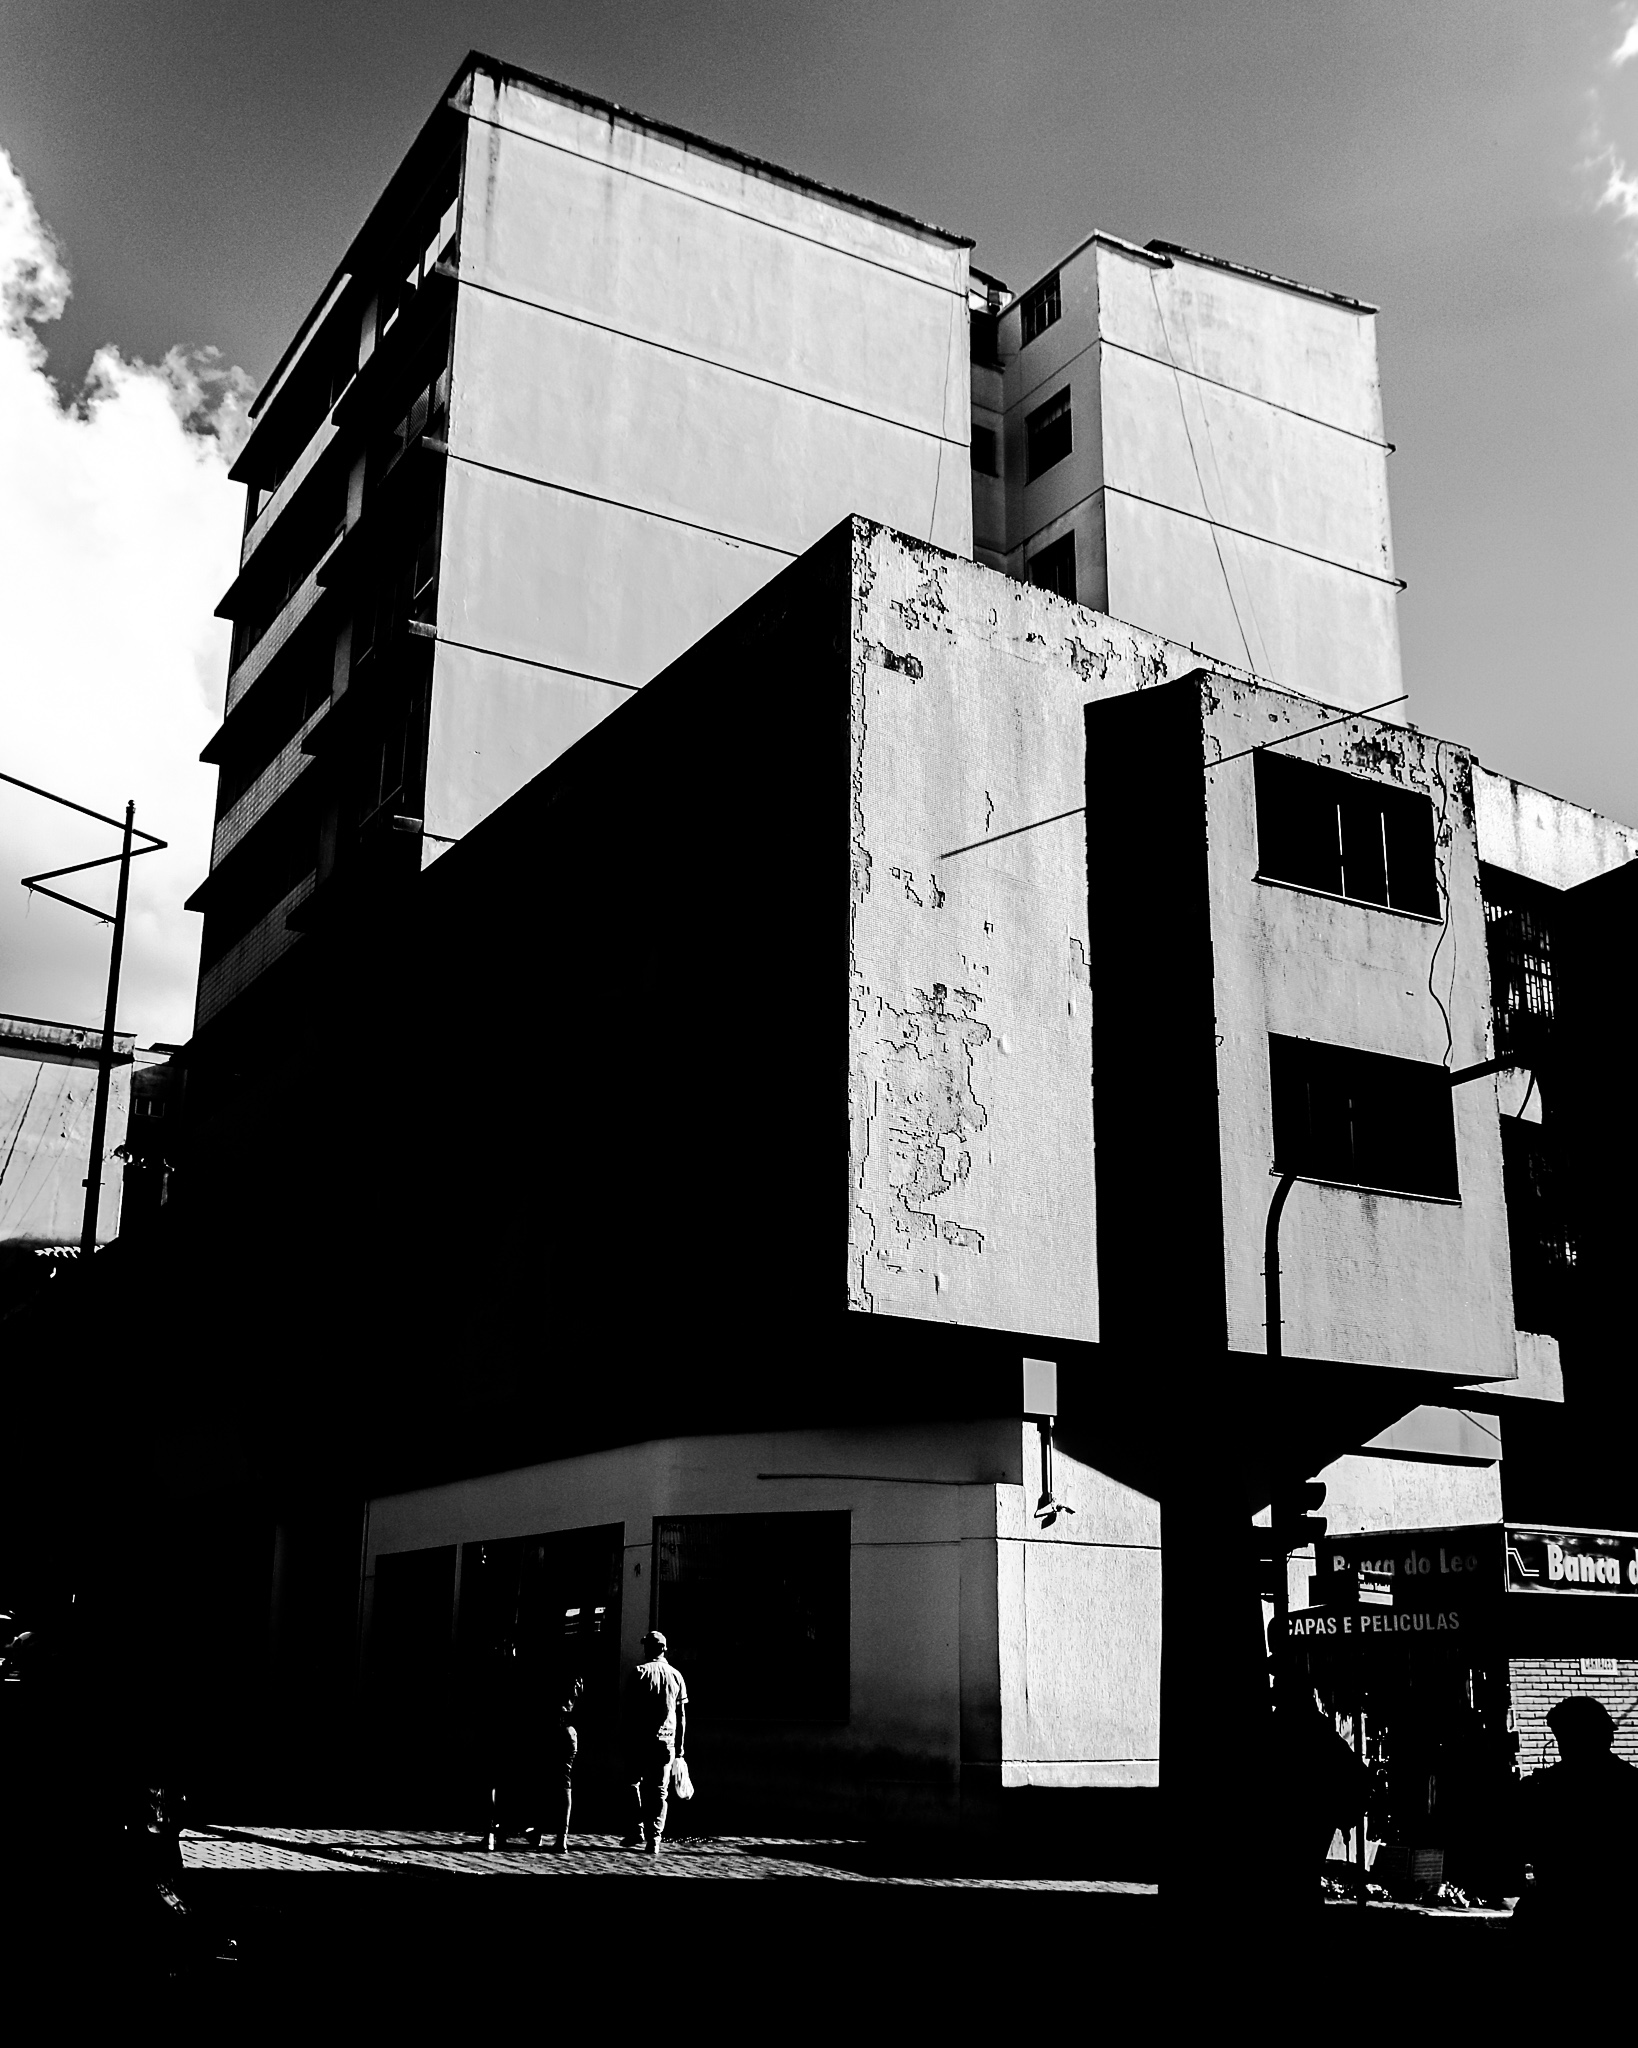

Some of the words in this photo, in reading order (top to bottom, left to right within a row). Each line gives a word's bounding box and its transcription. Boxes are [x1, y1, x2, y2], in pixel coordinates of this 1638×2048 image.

[1404, 1548, 1431, 1575] do
[1439, 1547, 1478, 1574] Leo
[1547, 1544, 1620, 1585] Banca
[1343, 1616, 1353, 1634] E
[1360, 1611, 1460, 1633] PELICULAS
